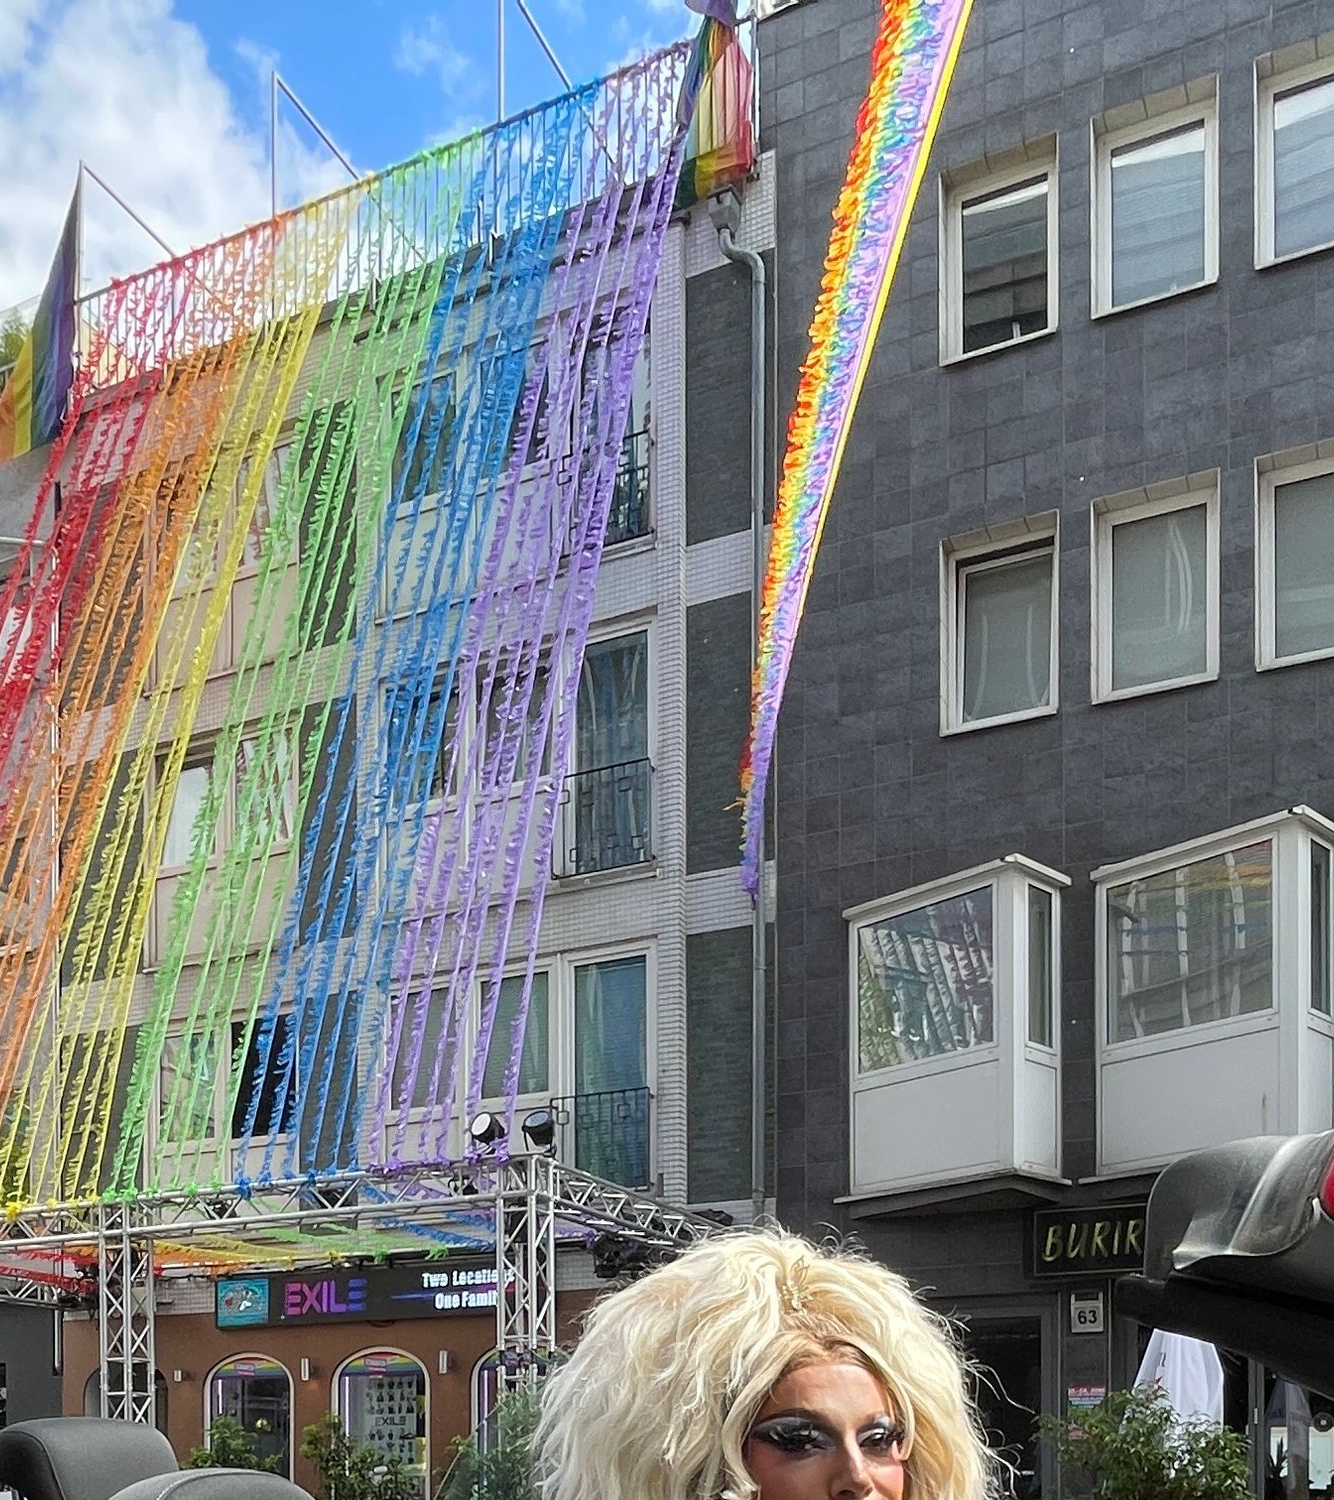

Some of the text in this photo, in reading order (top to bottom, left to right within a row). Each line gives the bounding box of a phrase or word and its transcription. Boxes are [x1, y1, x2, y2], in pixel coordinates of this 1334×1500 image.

[1042, 1219, 1145, 1262] BURIR
[422, 1272, 448, 1288] Two
[285, 1277, 367, 1316] EXILE
[435, 1292, 461, 1310] One
[1078, 1310, 1097, 1325] 63
[375, 1416, 406, 1427] EXILE
